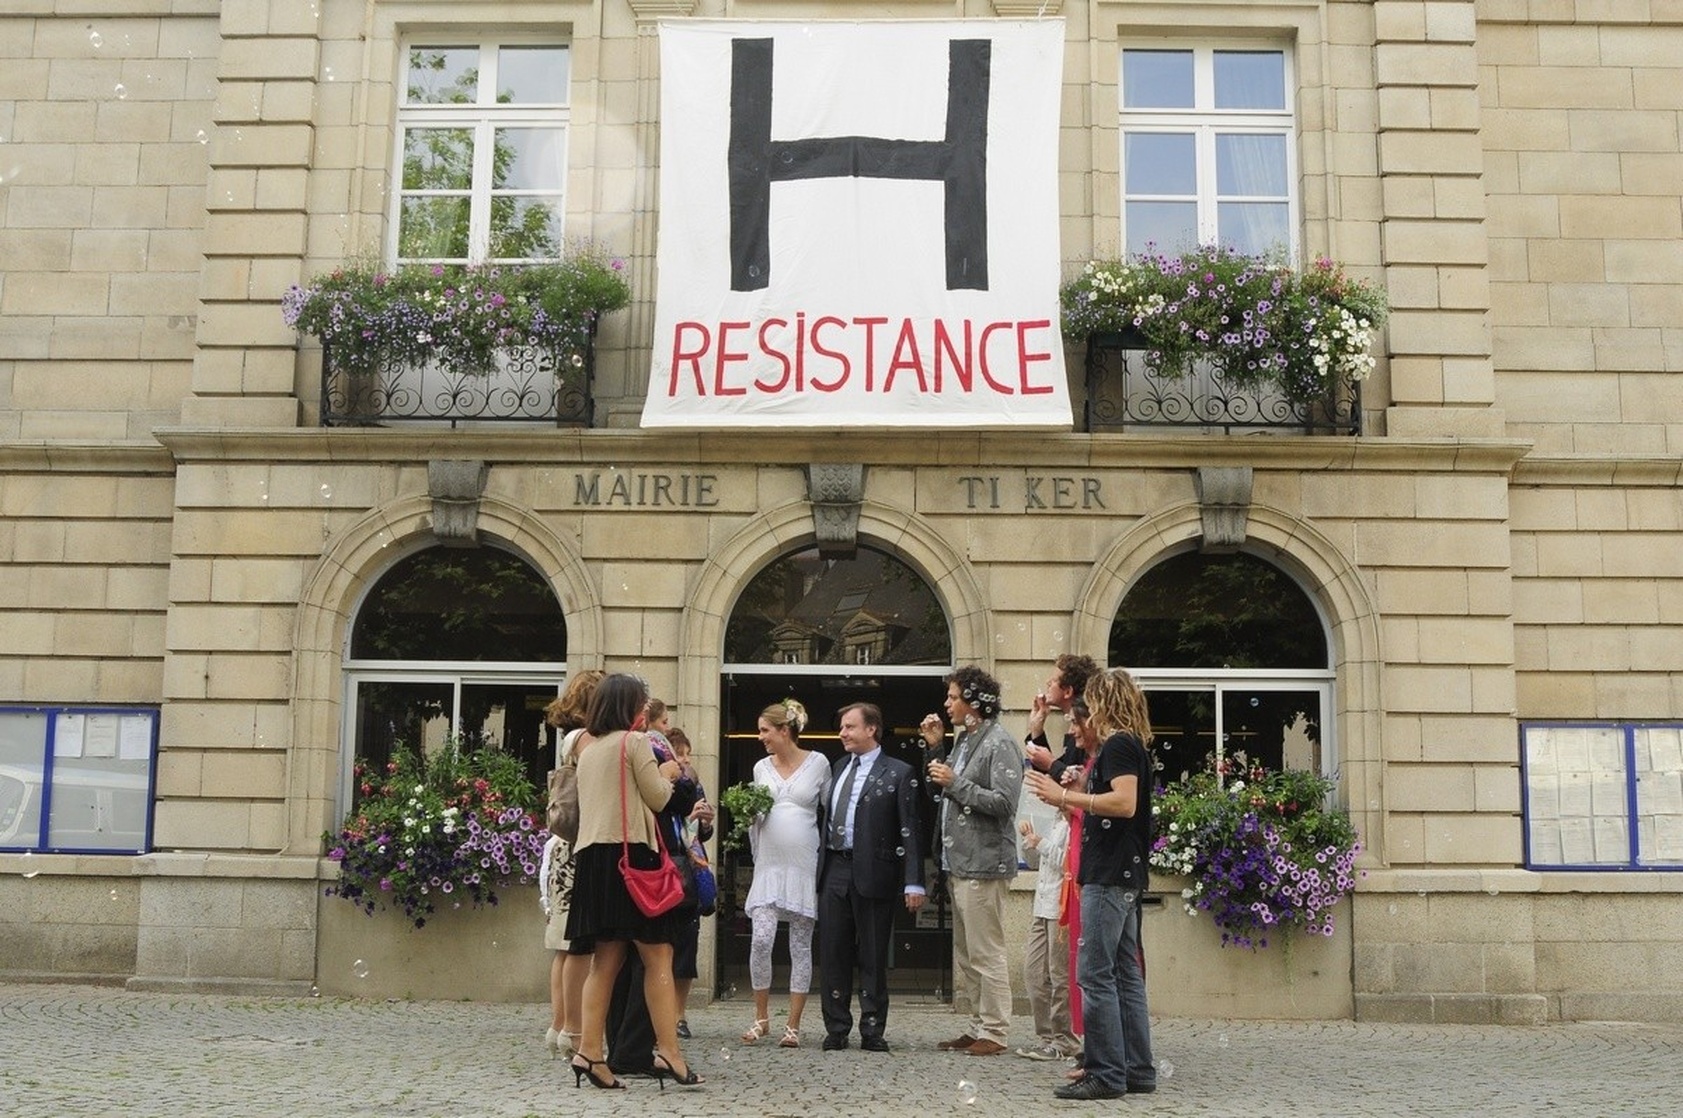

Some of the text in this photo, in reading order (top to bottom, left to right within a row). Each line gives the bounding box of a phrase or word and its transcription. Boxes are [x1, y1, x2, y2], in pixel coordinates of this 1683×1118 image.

[728, 37, 992, 292] H
[573, 474, 720, 507] MAIRIE
[957, 476, 1106, 510] TI KER
